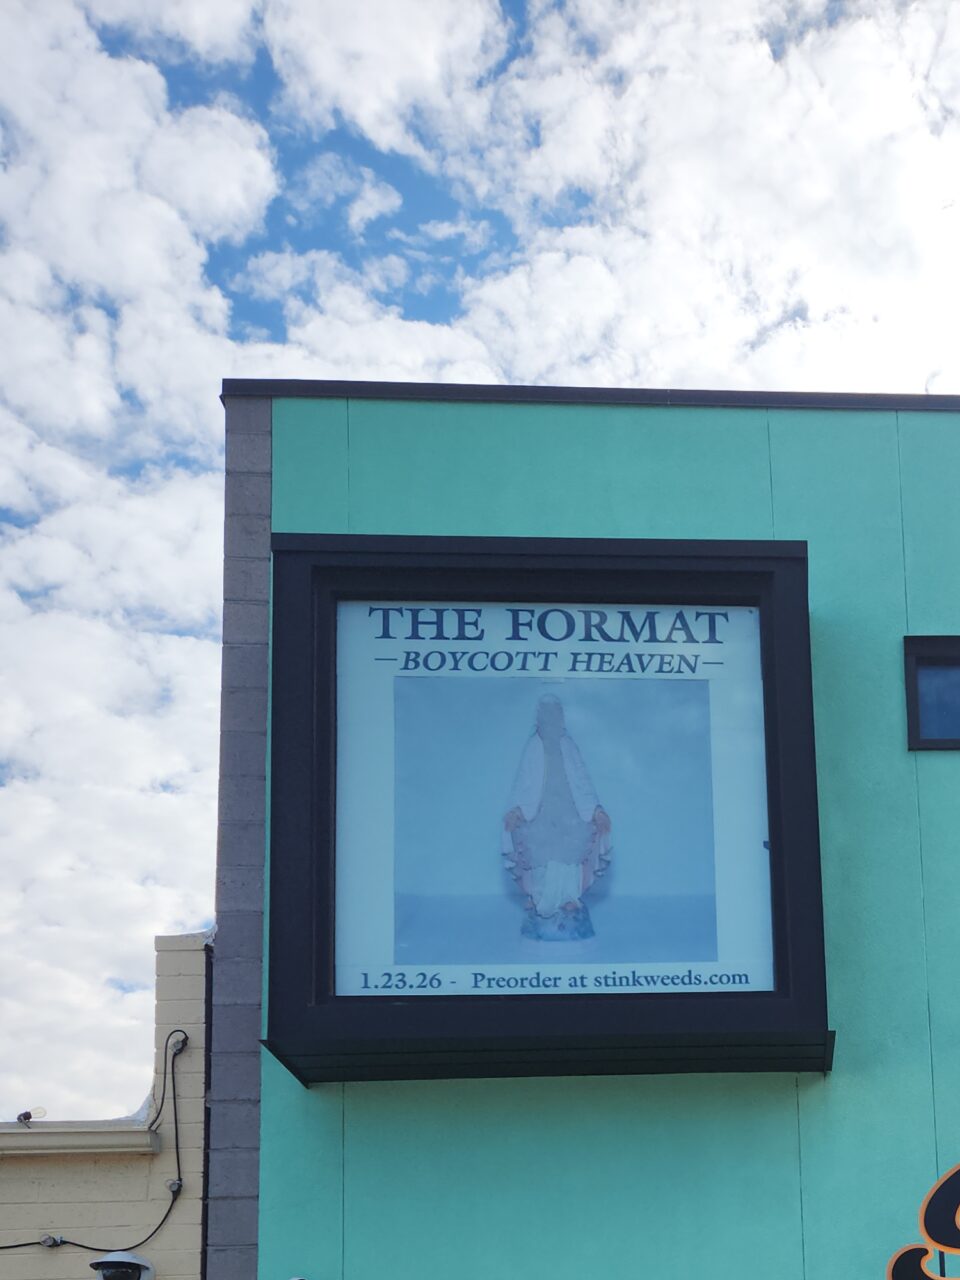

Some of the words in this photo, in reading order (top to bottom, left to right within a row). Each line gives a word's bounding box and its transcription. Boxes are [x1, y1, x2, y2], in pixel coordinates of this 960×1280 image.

[369, 606, 485, 641] THE
[505, 608, 729, 644] FORMAT
[400, 651, 558, 672] BOYCOTT
[568, 652, 701, 674] HEAVEN
[361, 972, 442, 989] 1.23.26
[472, 972, 561, 988] Preorder
[568, 974, 588, 988] at
[593, 970, 750, 987] stinkweeds.com
